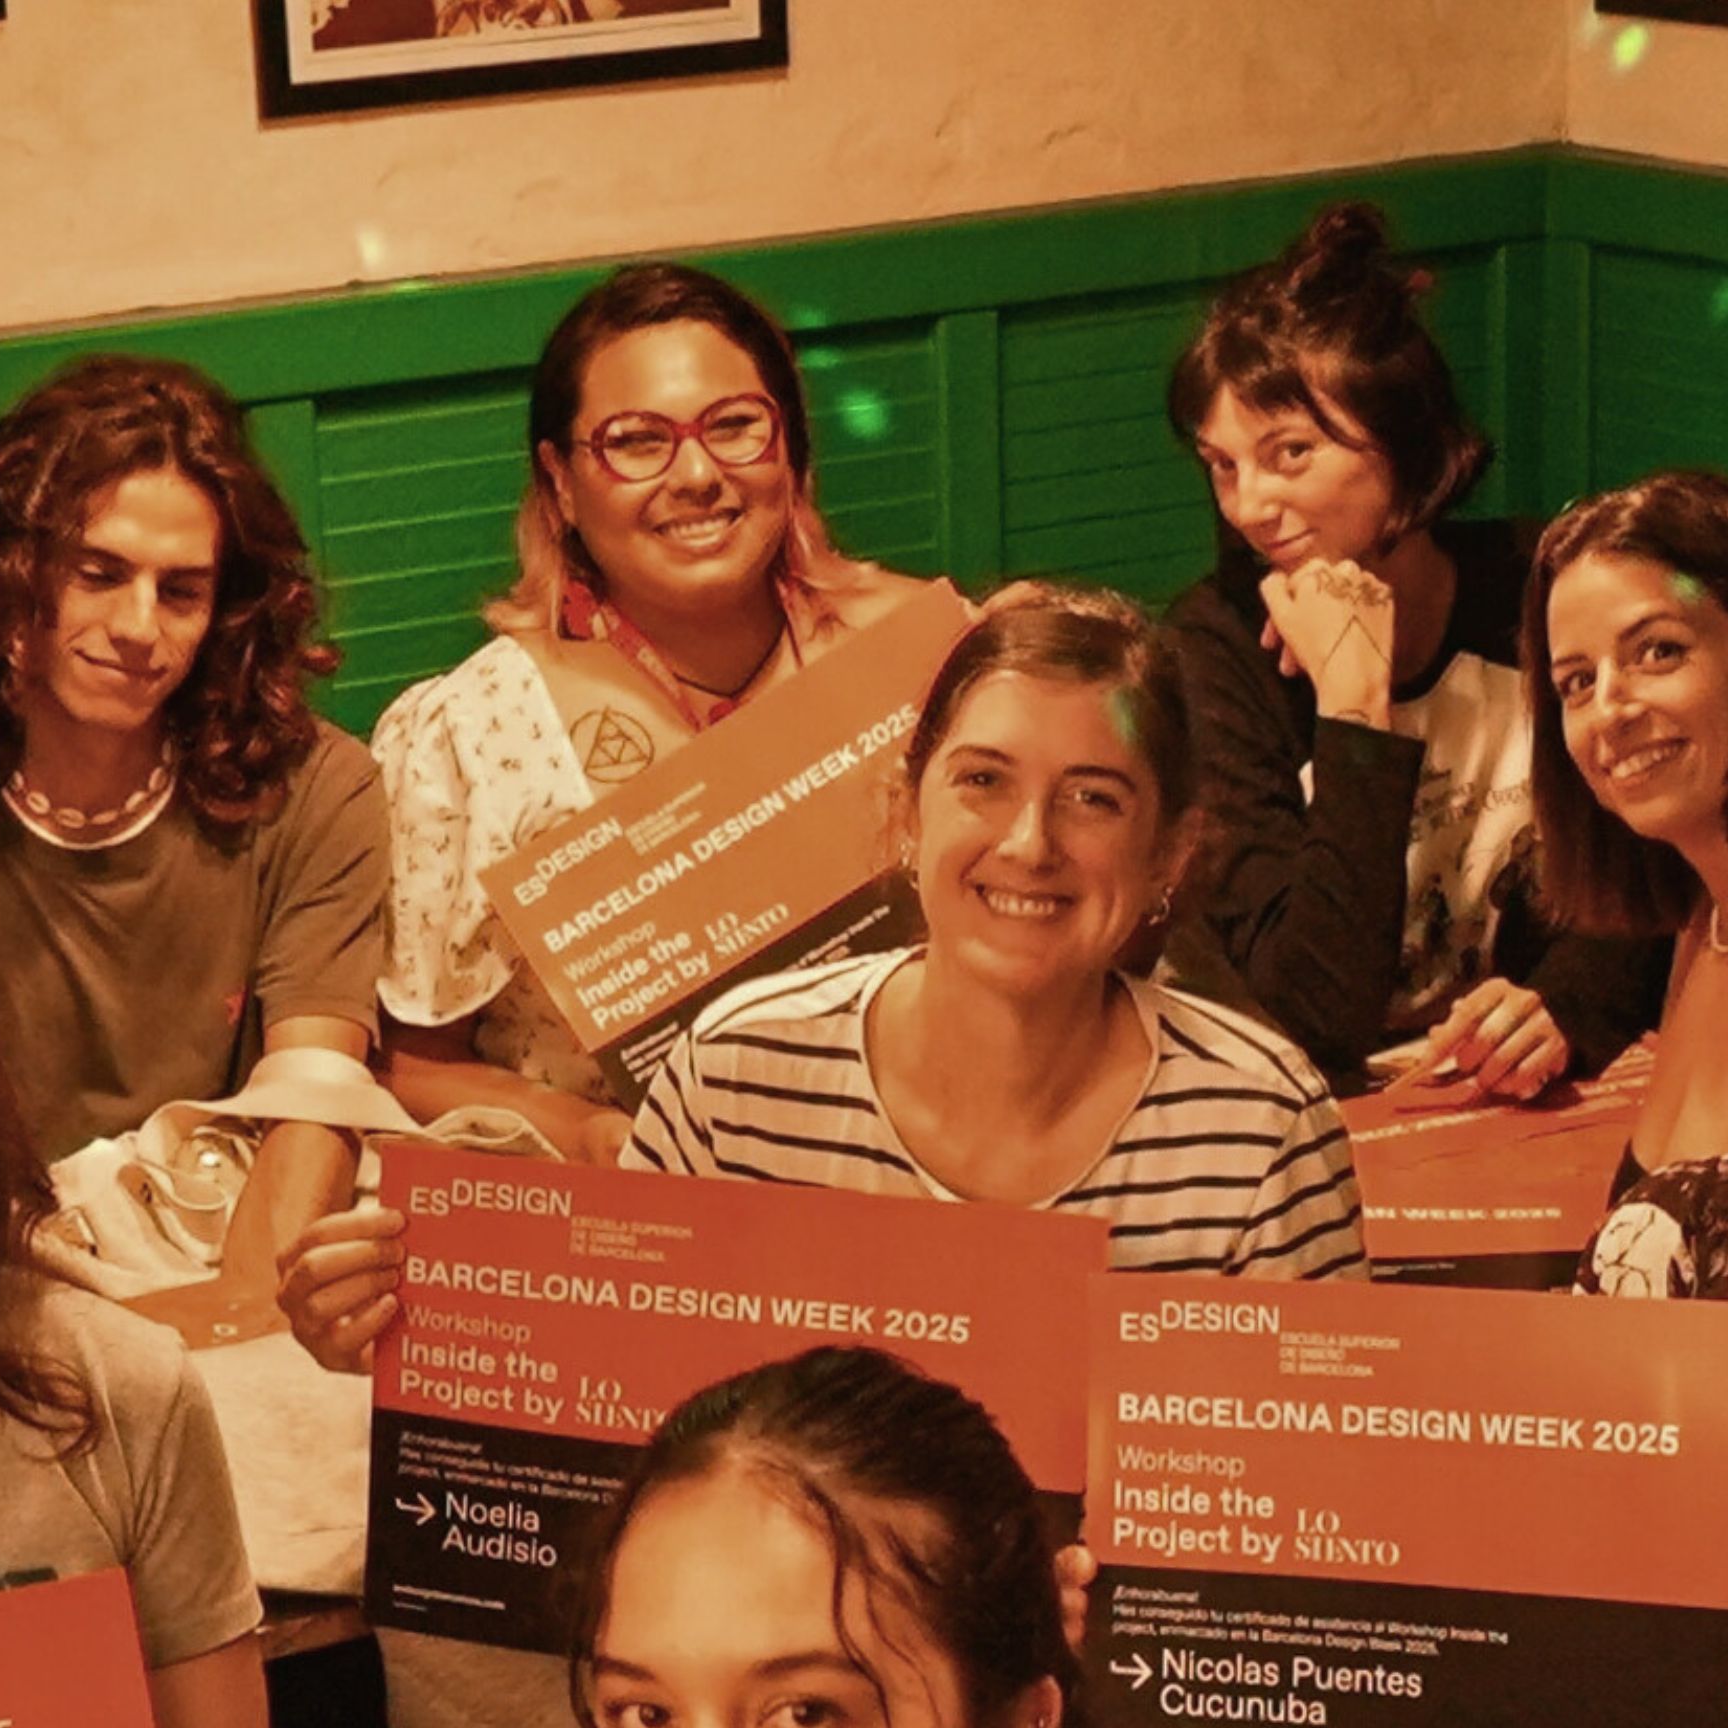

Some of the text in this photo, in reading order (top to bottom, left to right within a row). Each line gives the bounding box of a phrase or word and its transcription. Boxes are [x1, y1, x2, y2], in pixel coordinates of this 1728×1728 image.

[512, 817, 623, 907] ESDESIGN
[543, 852, 695, 953] BARCELONA
[691, 791, 786, 862] DESIGN
[782, 744, 860, 801] WEEK
[409, 1178, 572, 1218] ESDESIGN
[406, 1255, 971, 1345] BARCELONA DESIGN WEEK 2025
[1119, 1300, 1280, 1343] ESDESIGN
[1118, 1392, 1680, 1456] BARCELONA DESIGN WEEK 2025
[445, 1491, 540, 1533] Noelia
[442, 1524, 558, 1567] Audisio
[1292, 1656, 1423, 1698] Puentes
[1159, 1683, 1327, 1726] Cucunuba
